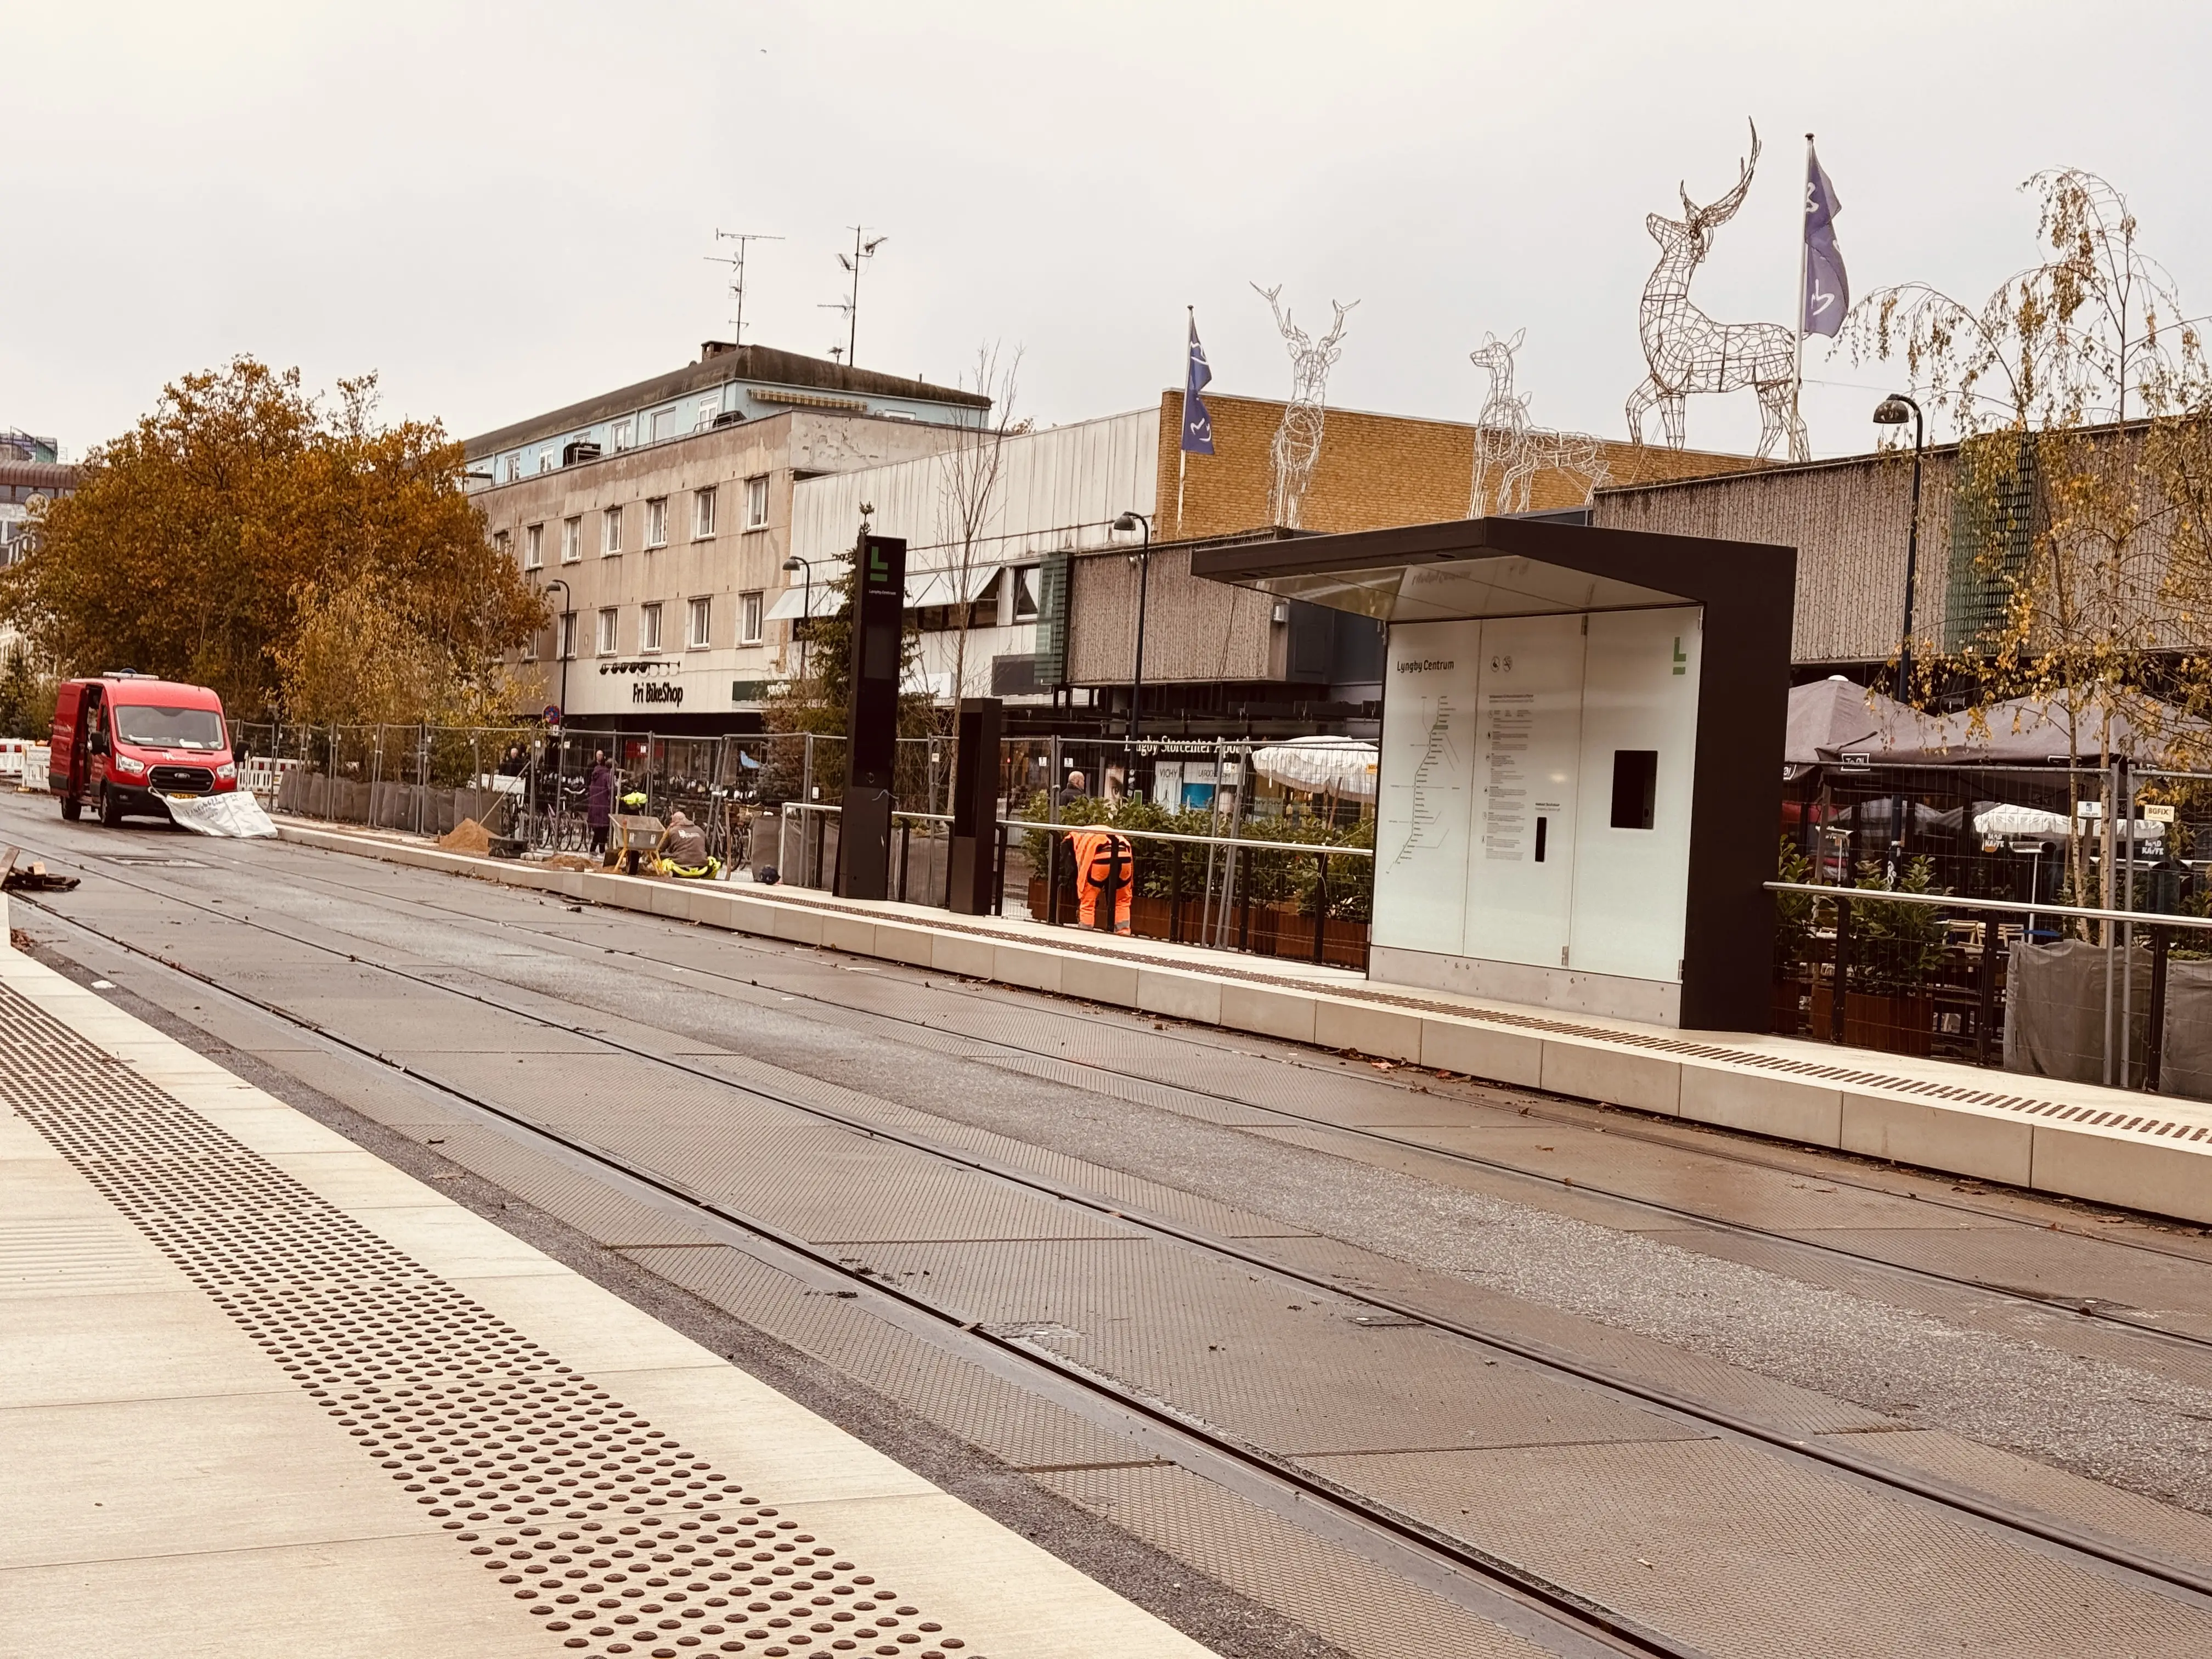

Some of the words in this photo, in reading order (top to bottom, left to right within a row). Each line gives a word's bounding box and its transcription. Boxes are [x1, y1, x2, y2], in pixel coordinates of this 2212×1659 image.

[1397, 660, 1423, 674] Lyngby
[1424, 659, 1454, 670] Centrum
[633, 681, 644, 703] Fri
[1124, 735, 1159, 757] Lngby
[1160, 769, 1178, 778] VICHY
[2148, 807, 2169, 815] BGFIX
